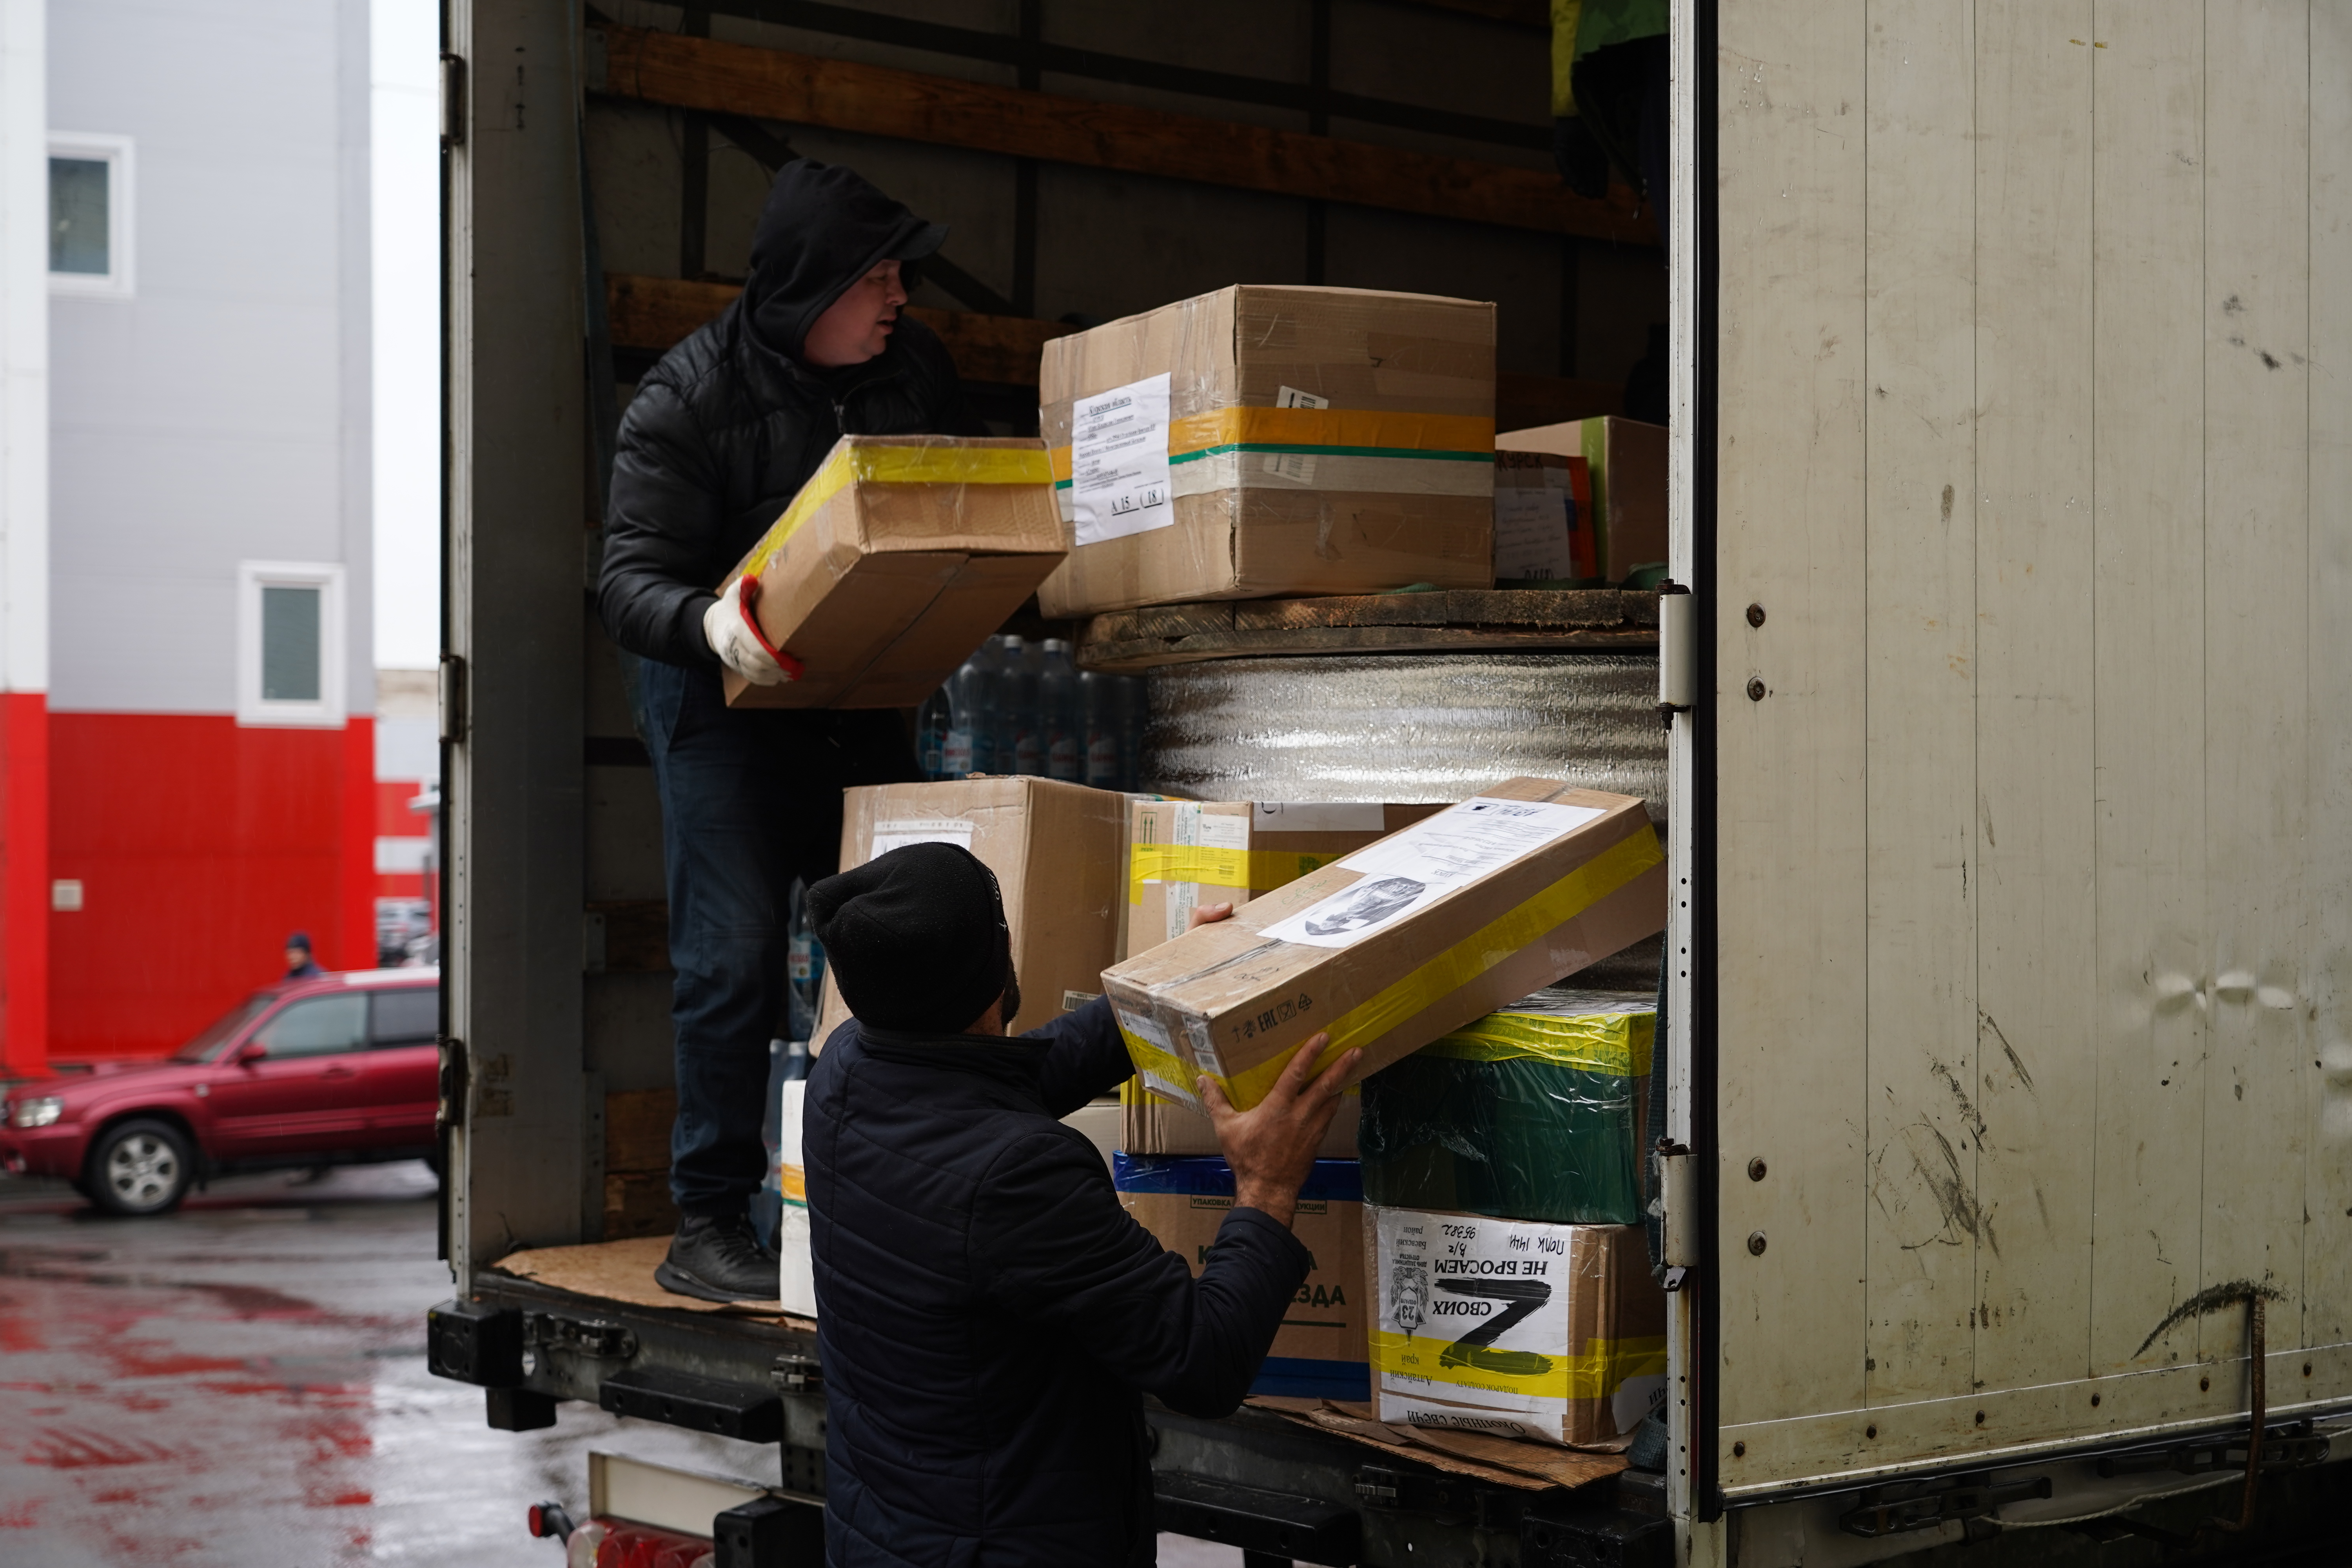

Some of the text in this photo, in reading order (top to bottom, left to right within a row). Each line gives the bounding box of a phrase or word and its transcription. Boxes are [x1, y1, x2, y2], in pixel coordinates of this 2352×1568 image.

[1496, 452, 1544, 472] КУРСК
[1121, 496, 1131, 510] 15
[1192, 1198, 1231, 1206] УПАКОВКА
[1403, 1226, 1424, 1236] район
[1441, 1224, 1476, 1240] 95382
[1396, 1238, 1427, 1250] Баевский
[1434, 1259, 1548, 1276] НЕ БРОСАЕМ
[1402, 1305, 1415, 1321] 23
[1432, 1301, 1492, 1316] СВОИХ
[1401, 1354, 1419, 1366] край
[1390, 1370, 1433, 1387] Алтайский
[1455, 1380, 1519, 1395] ПОДАРОК СОЛДАТУ
[1406, 1410, 1526, 1434] Окопные свечи
